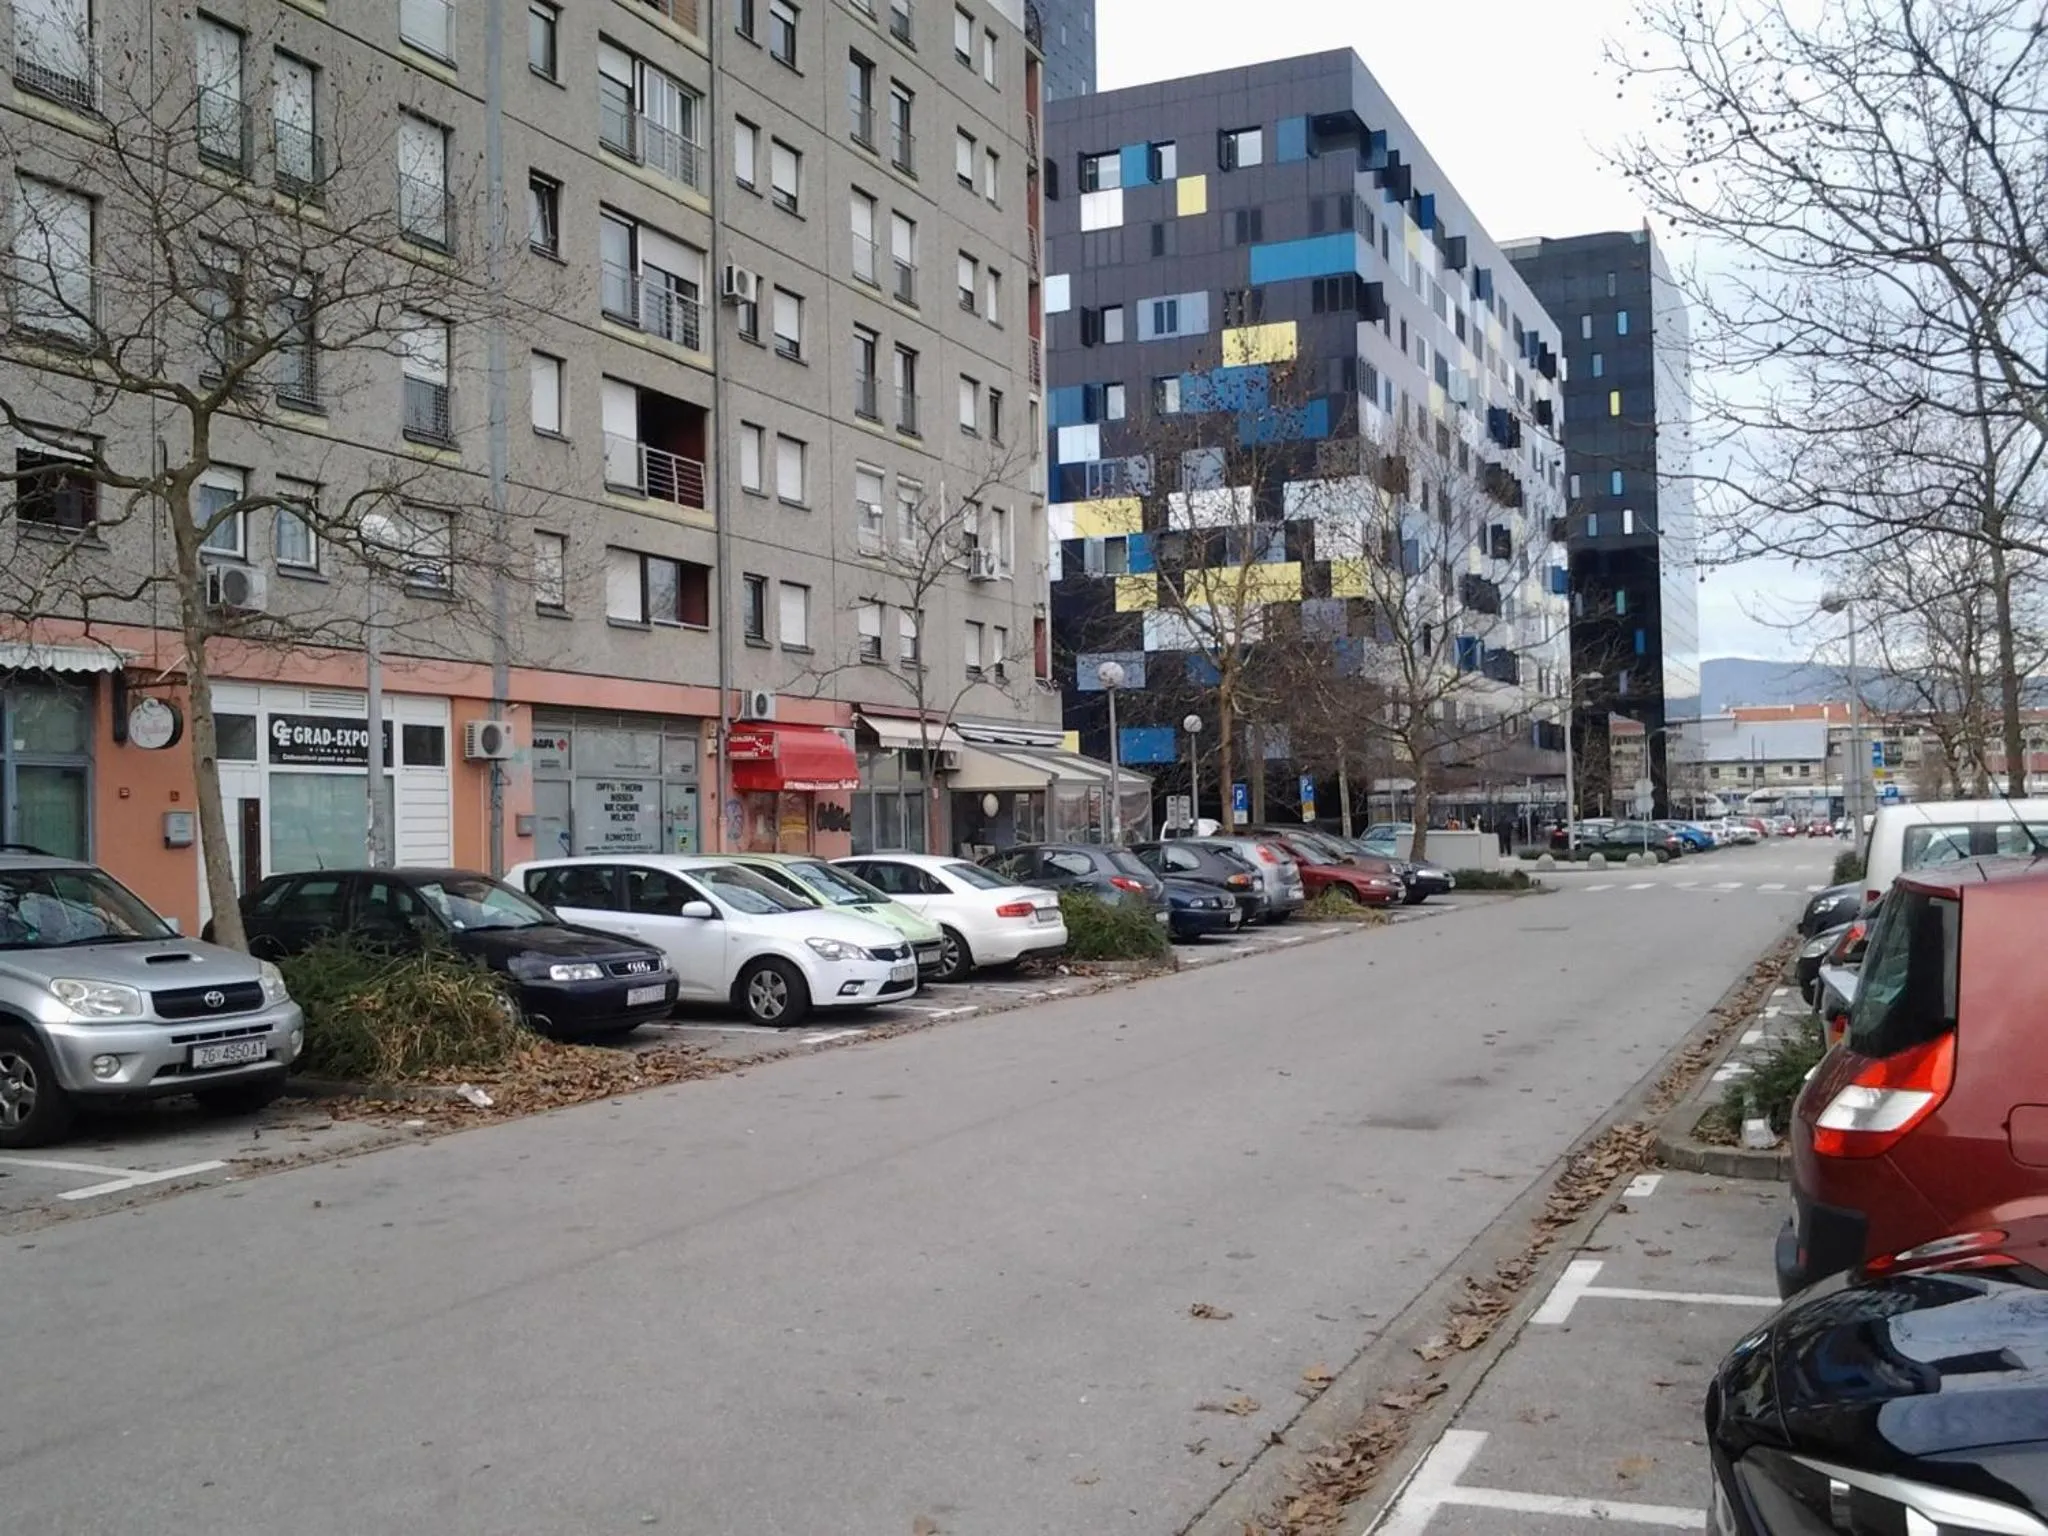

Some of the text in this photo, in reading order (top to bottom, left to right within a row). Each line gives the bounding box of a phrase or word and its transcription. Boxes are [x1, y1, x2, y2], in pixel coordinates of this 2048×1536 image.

[293, 725, 388, 749] GRAD-EXPO
[1236, 790, 1243, 805] P
[201, 1048, 216, 1064] ZG
